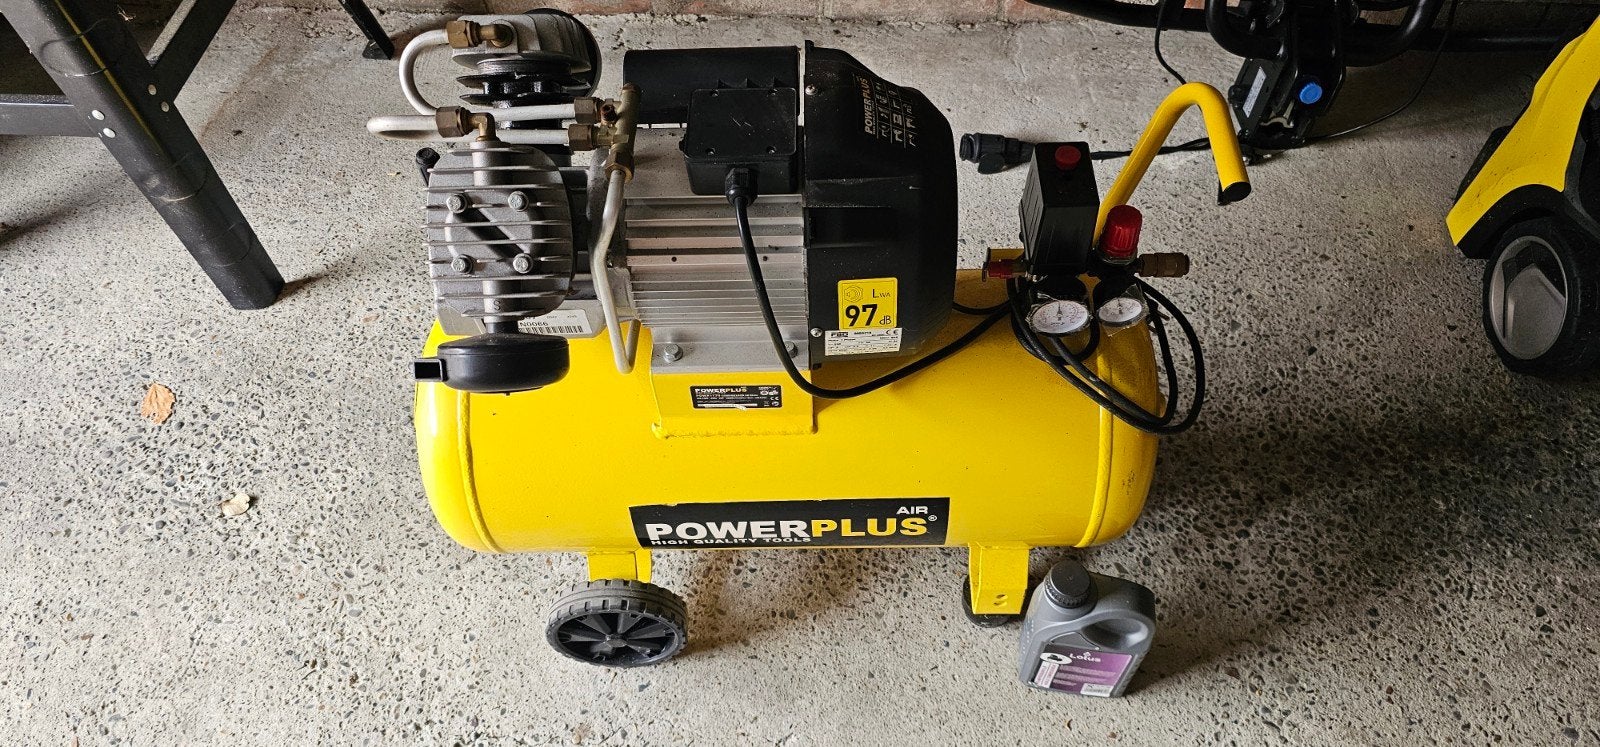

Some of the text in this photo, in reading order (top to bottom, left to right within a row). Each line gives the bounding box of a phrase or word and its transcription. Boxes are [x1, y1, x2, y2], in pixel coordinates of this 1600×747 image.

[845, 304, 892, 327] 97 dB
[896, 505, 929, 515] AIR
[693, 537, 757, 545] QUALITY
[1069, 651, 1102, 663] Lotus
